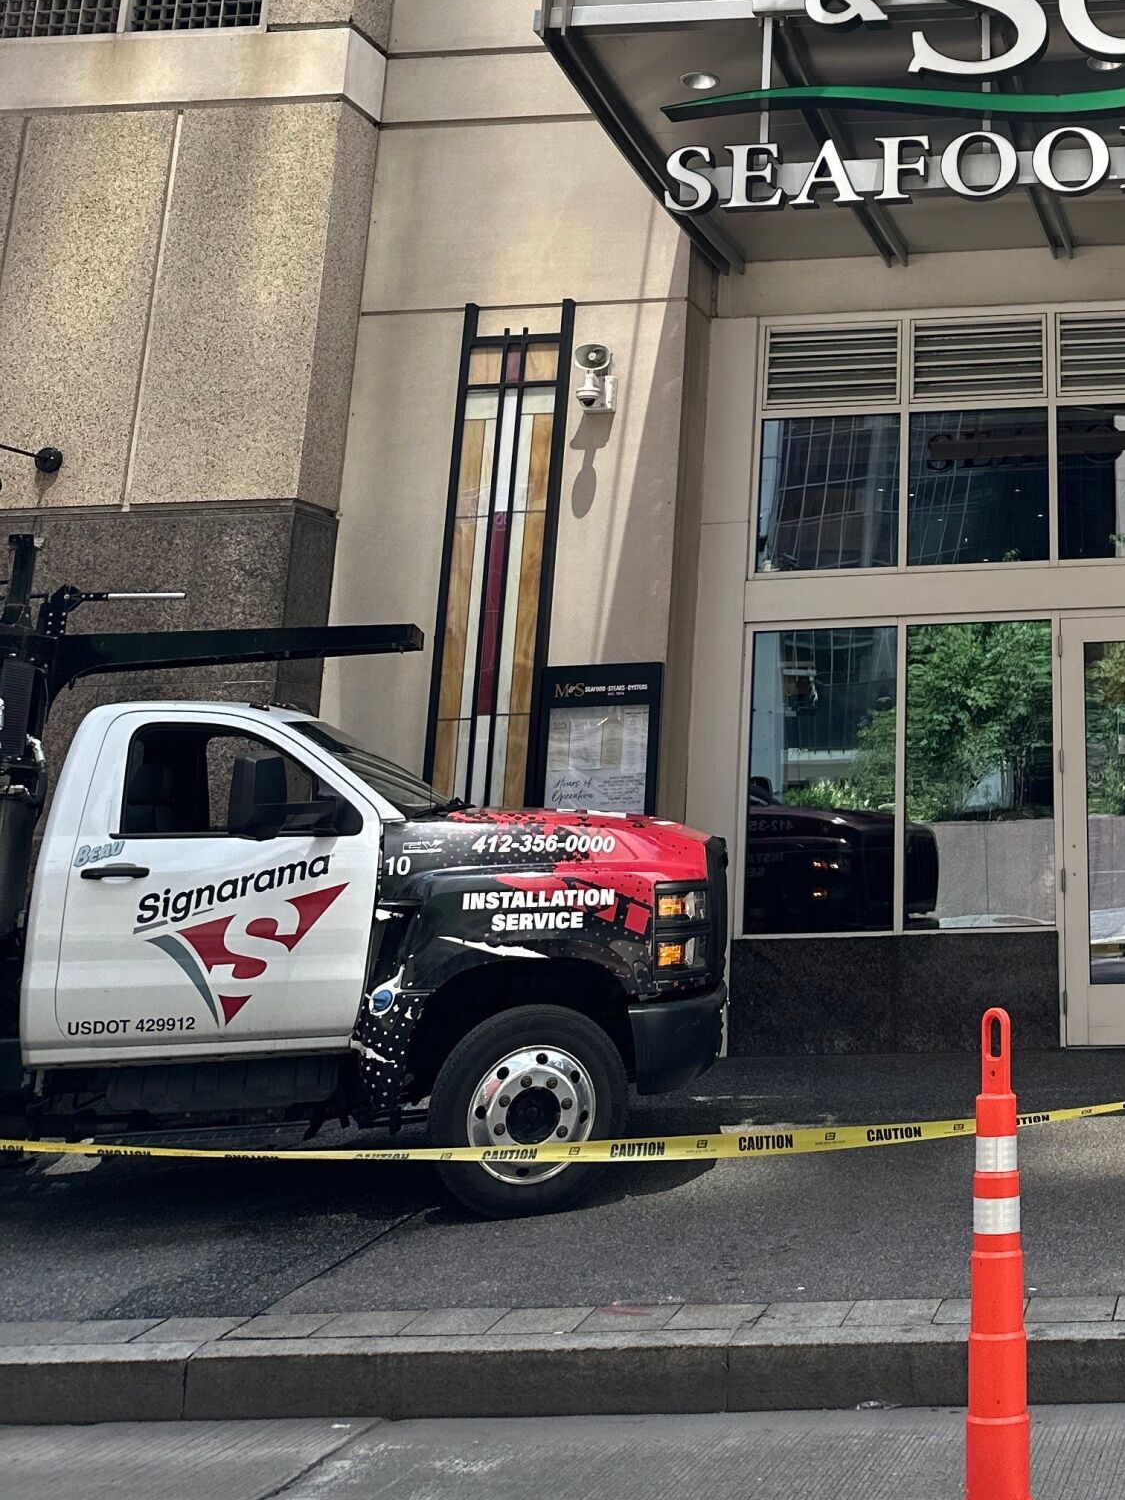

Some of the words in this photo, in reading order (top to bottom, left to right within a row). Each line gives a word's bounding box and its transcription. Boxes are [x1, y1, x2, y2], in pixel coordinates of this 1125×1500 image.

[471, 835, 616, 853] 412-356-0000
[385, 856, 411, 876] 10
[136, 854, 331, 923] Signarama
[462, 889, 615, 910] INSTALLATION
[491, 911, 584, 932] SERVICE
[67, 1020, 131, 1036] USDOT
[135, 1017, 196, 1033] 429912
[738, 1134, 793, 1151] CAUTION
[867, 1126, 922, 1142] CAUTION
[482, 1148, 537, 1160] CAUTION
[610, 1142, 665, 1158] CAUTION
